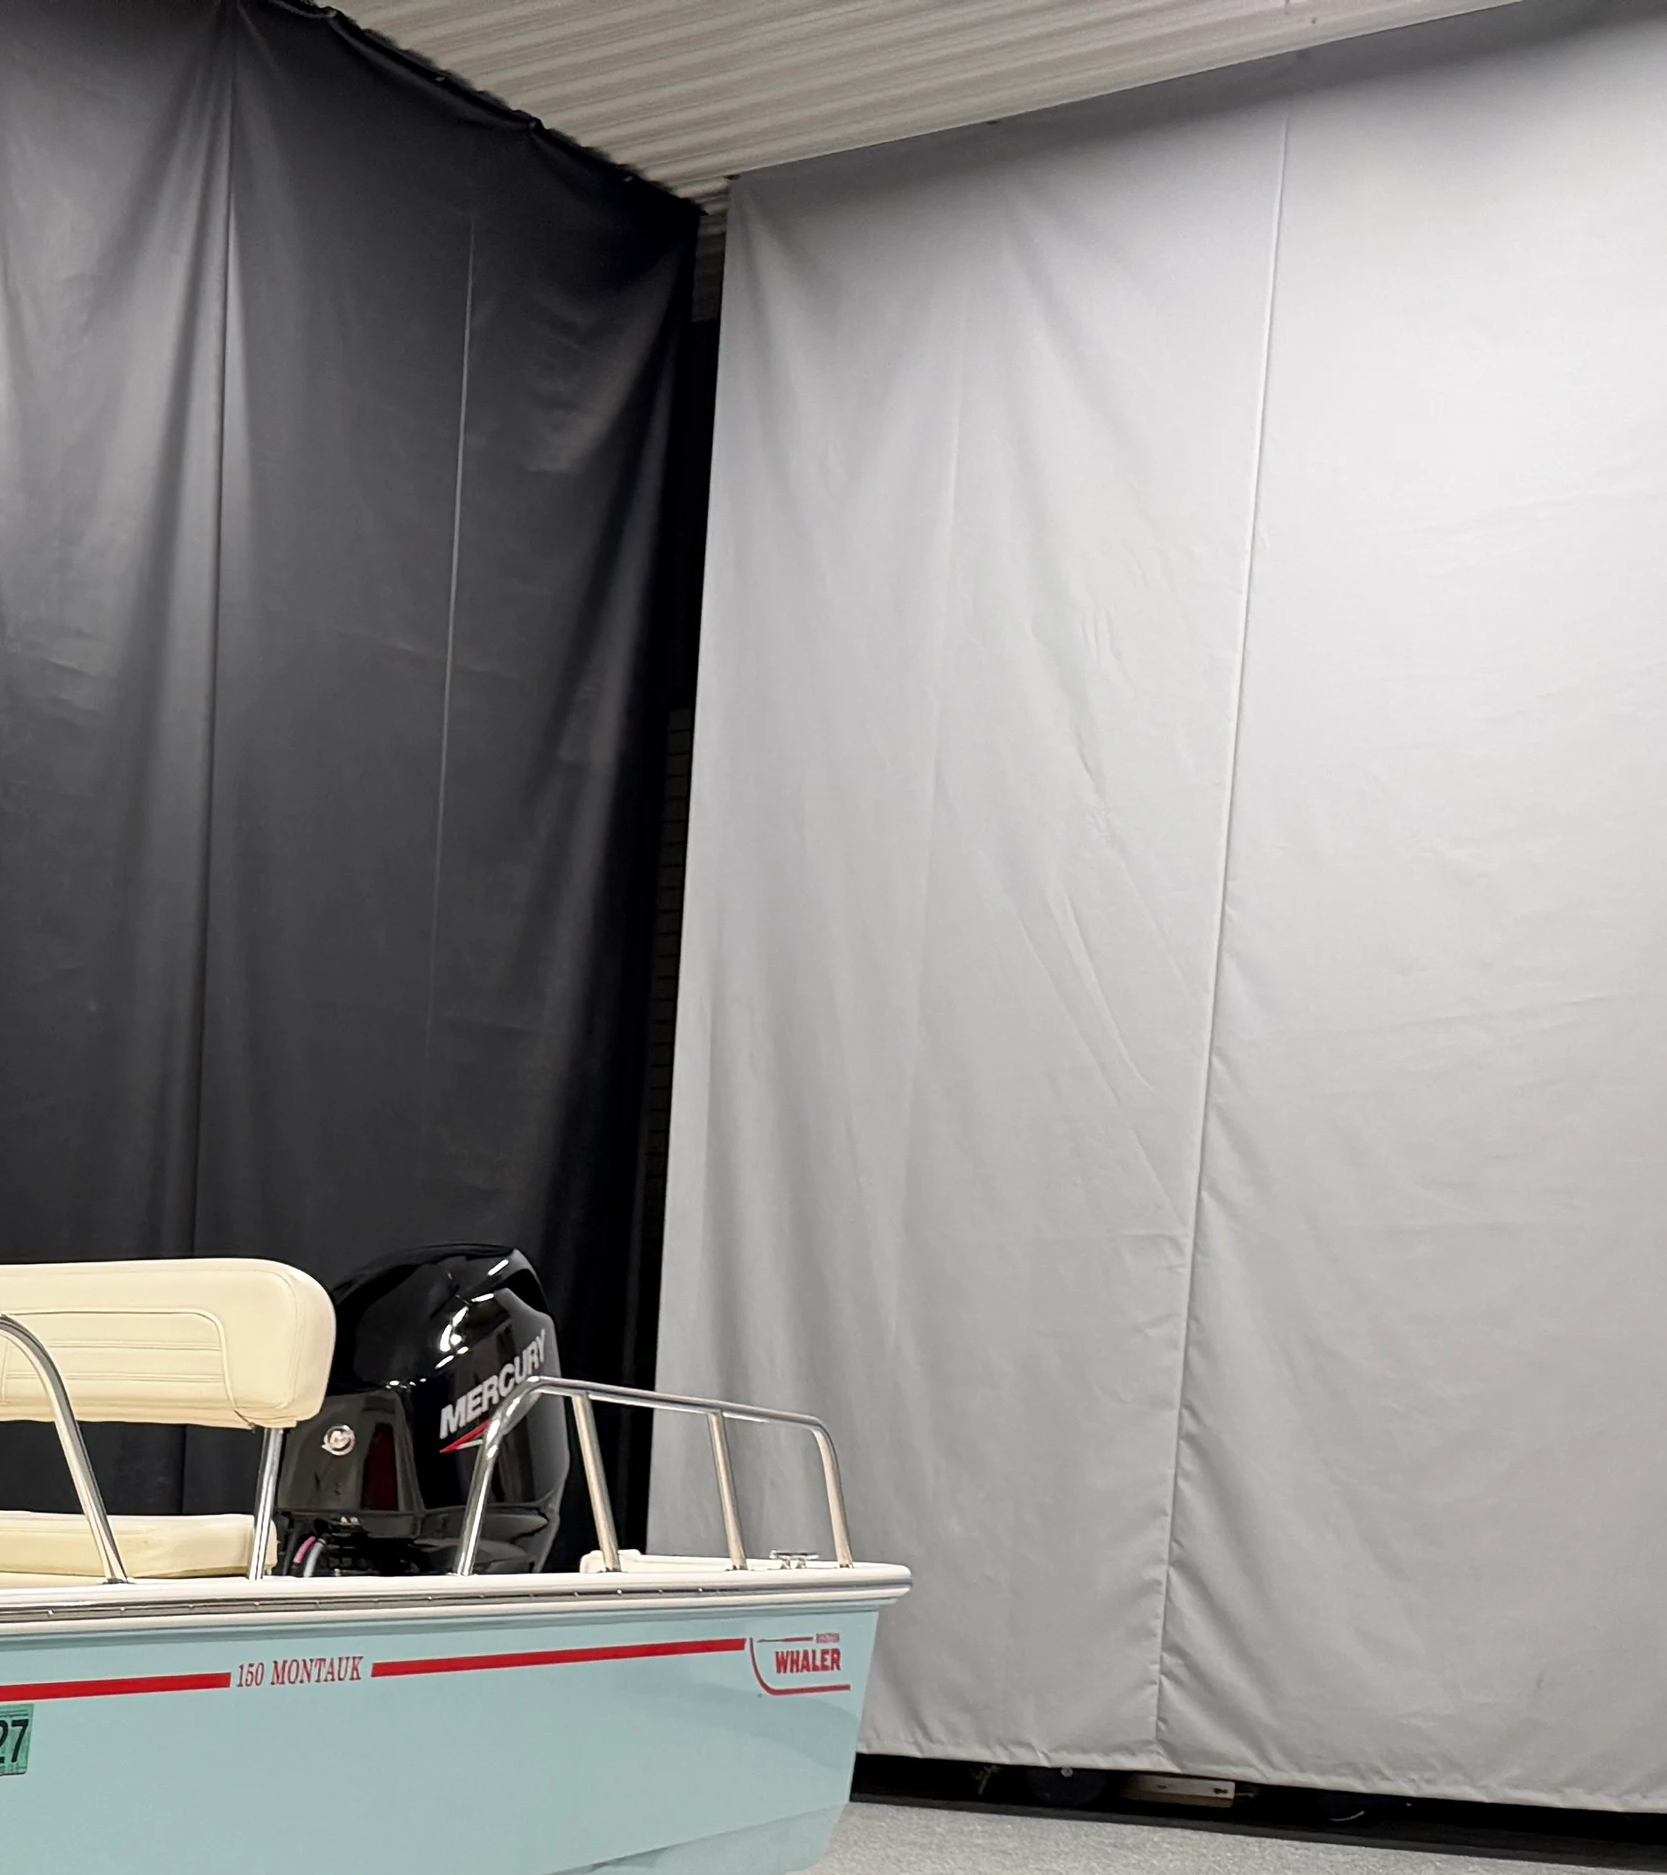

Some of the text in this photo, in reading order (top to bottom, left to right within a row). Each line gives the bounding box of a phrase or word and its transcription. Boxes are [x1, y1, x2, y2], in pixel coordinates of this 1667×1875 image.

[439, 1328, 545, 1439] MERCURY
[237, 1656, 364, 1688] 150 MONTAUK
[775, 1648, 841, 1674] WHALER
